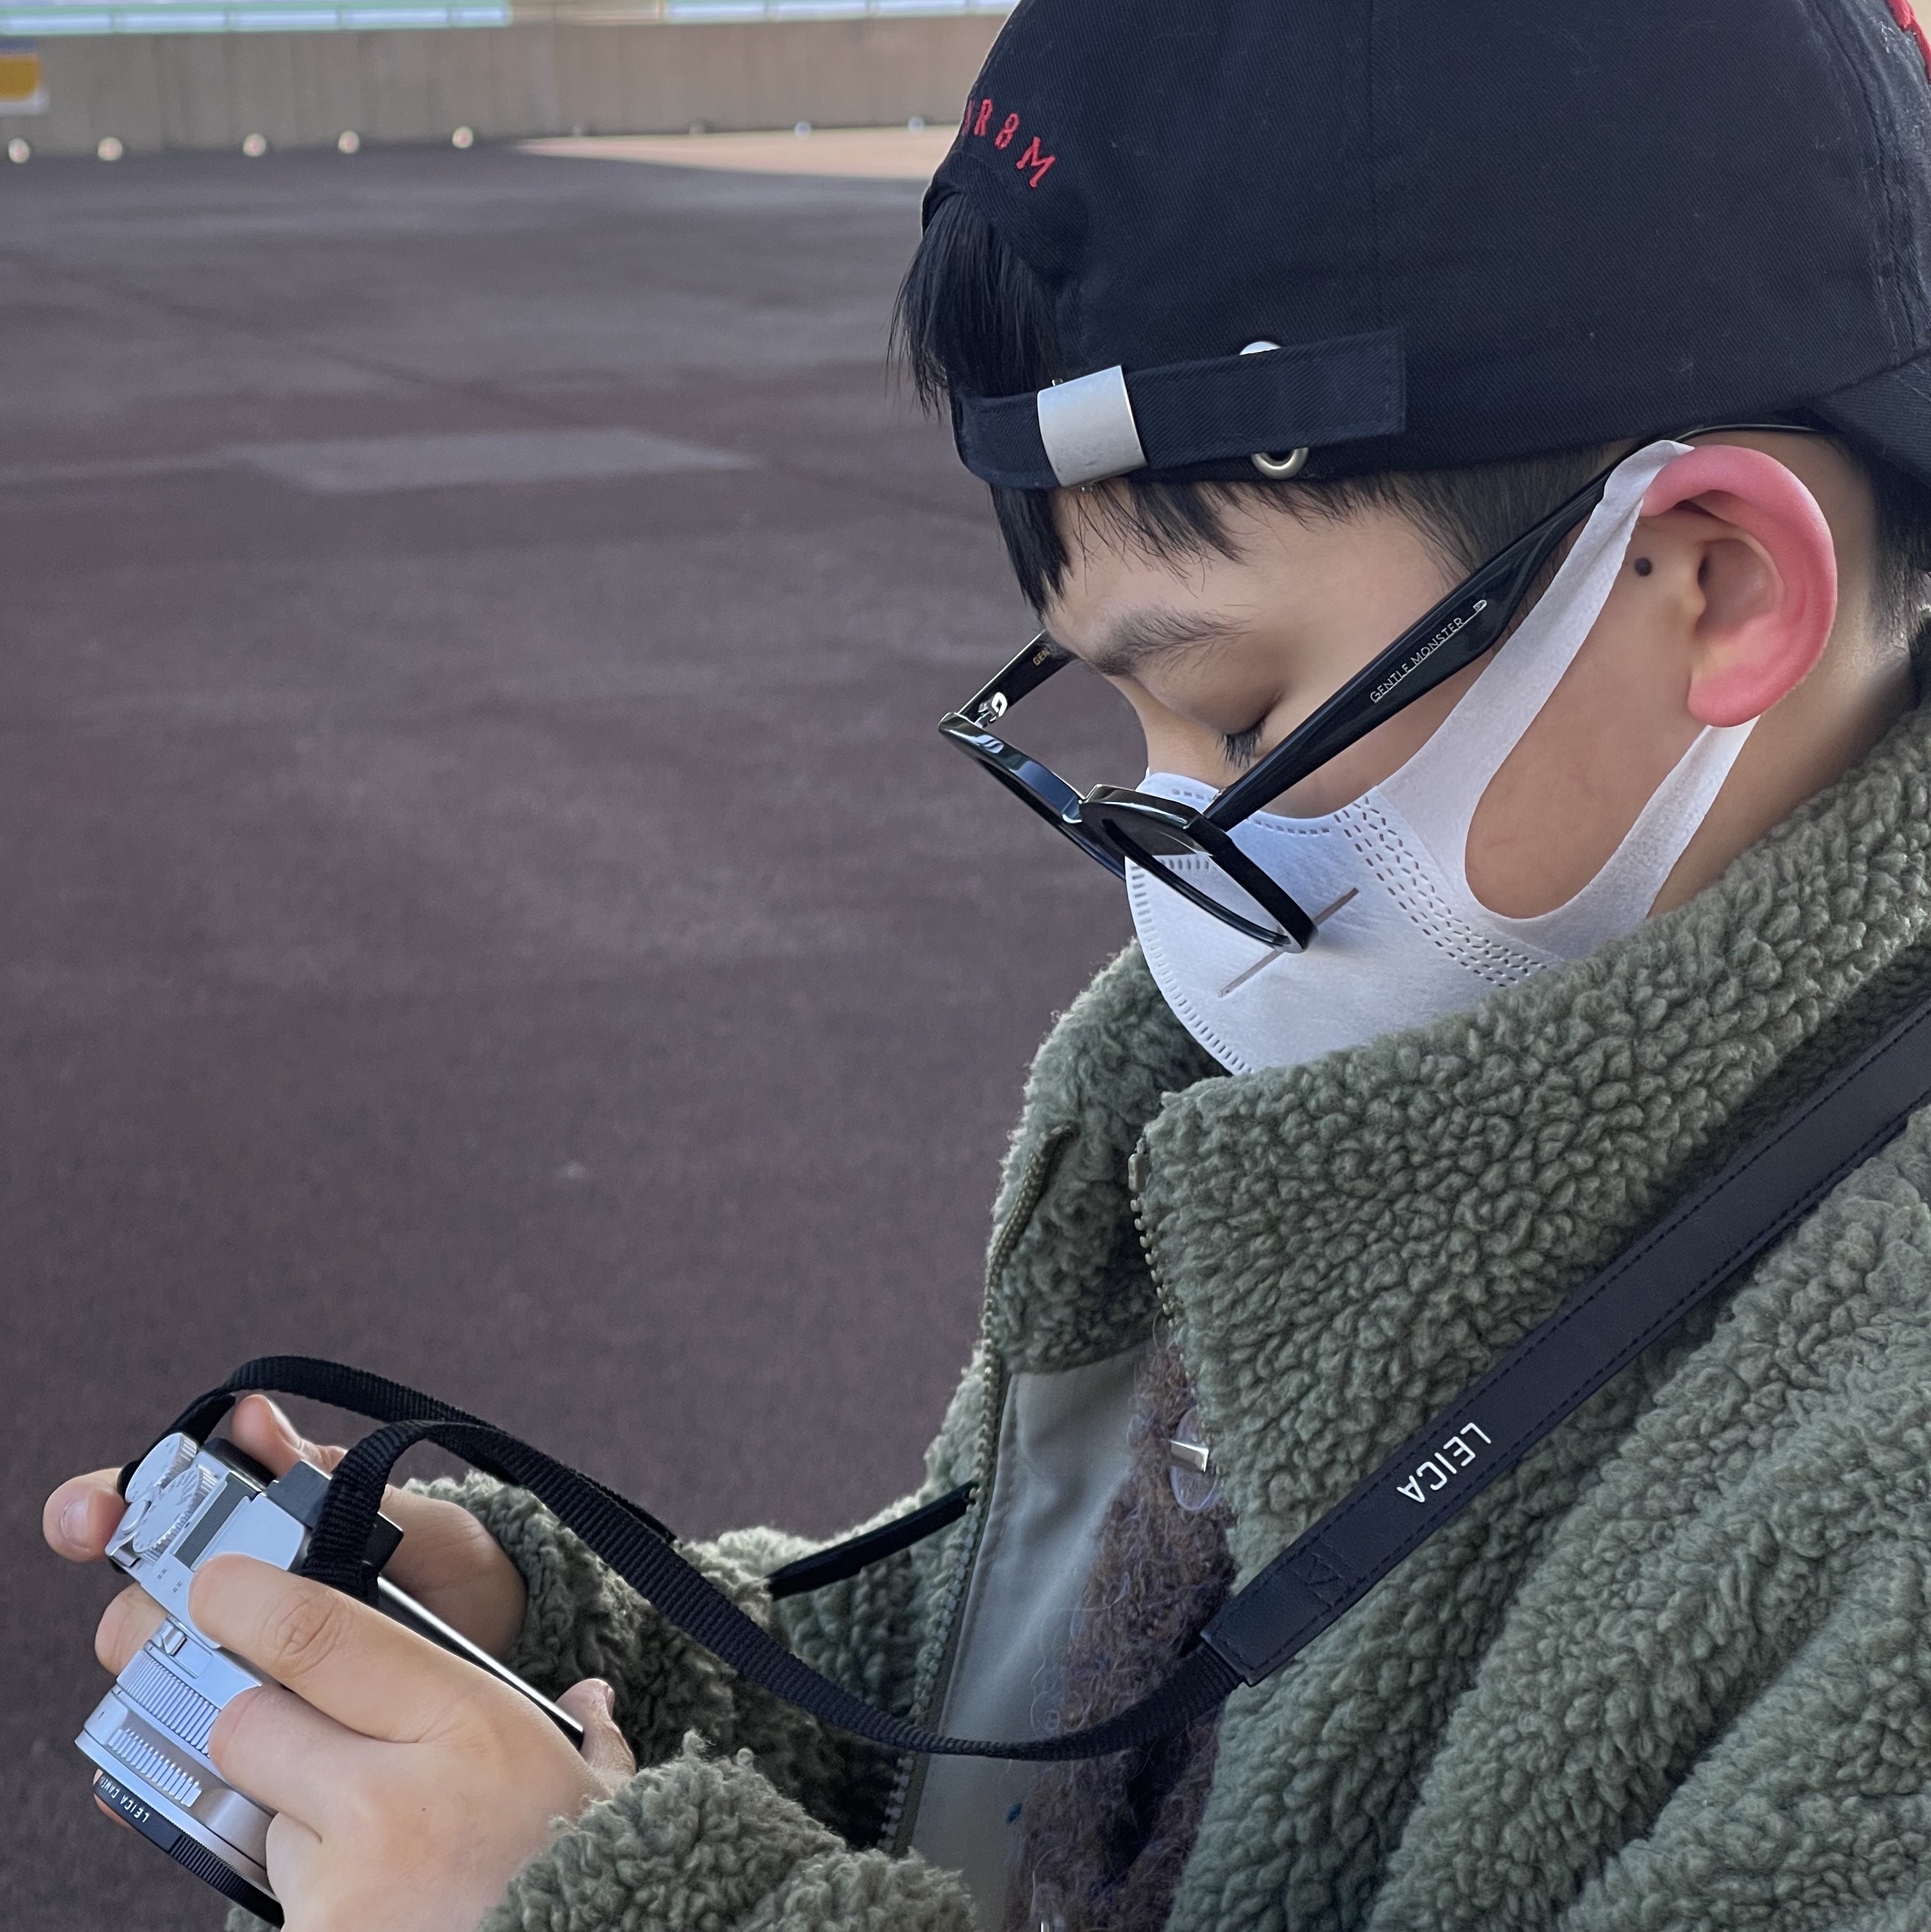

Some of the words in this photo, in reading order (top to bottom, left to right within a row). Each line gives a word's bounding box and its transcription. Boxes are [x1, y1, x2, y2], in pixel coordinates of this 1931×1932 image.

[1370, 662, 1411, 703] GENTLE
[1411, 617, 1465, 667] MONSTER
[1396, 1422, 1491, 1503] LEICA
[119, 1795, 150, 1823] LEICA
